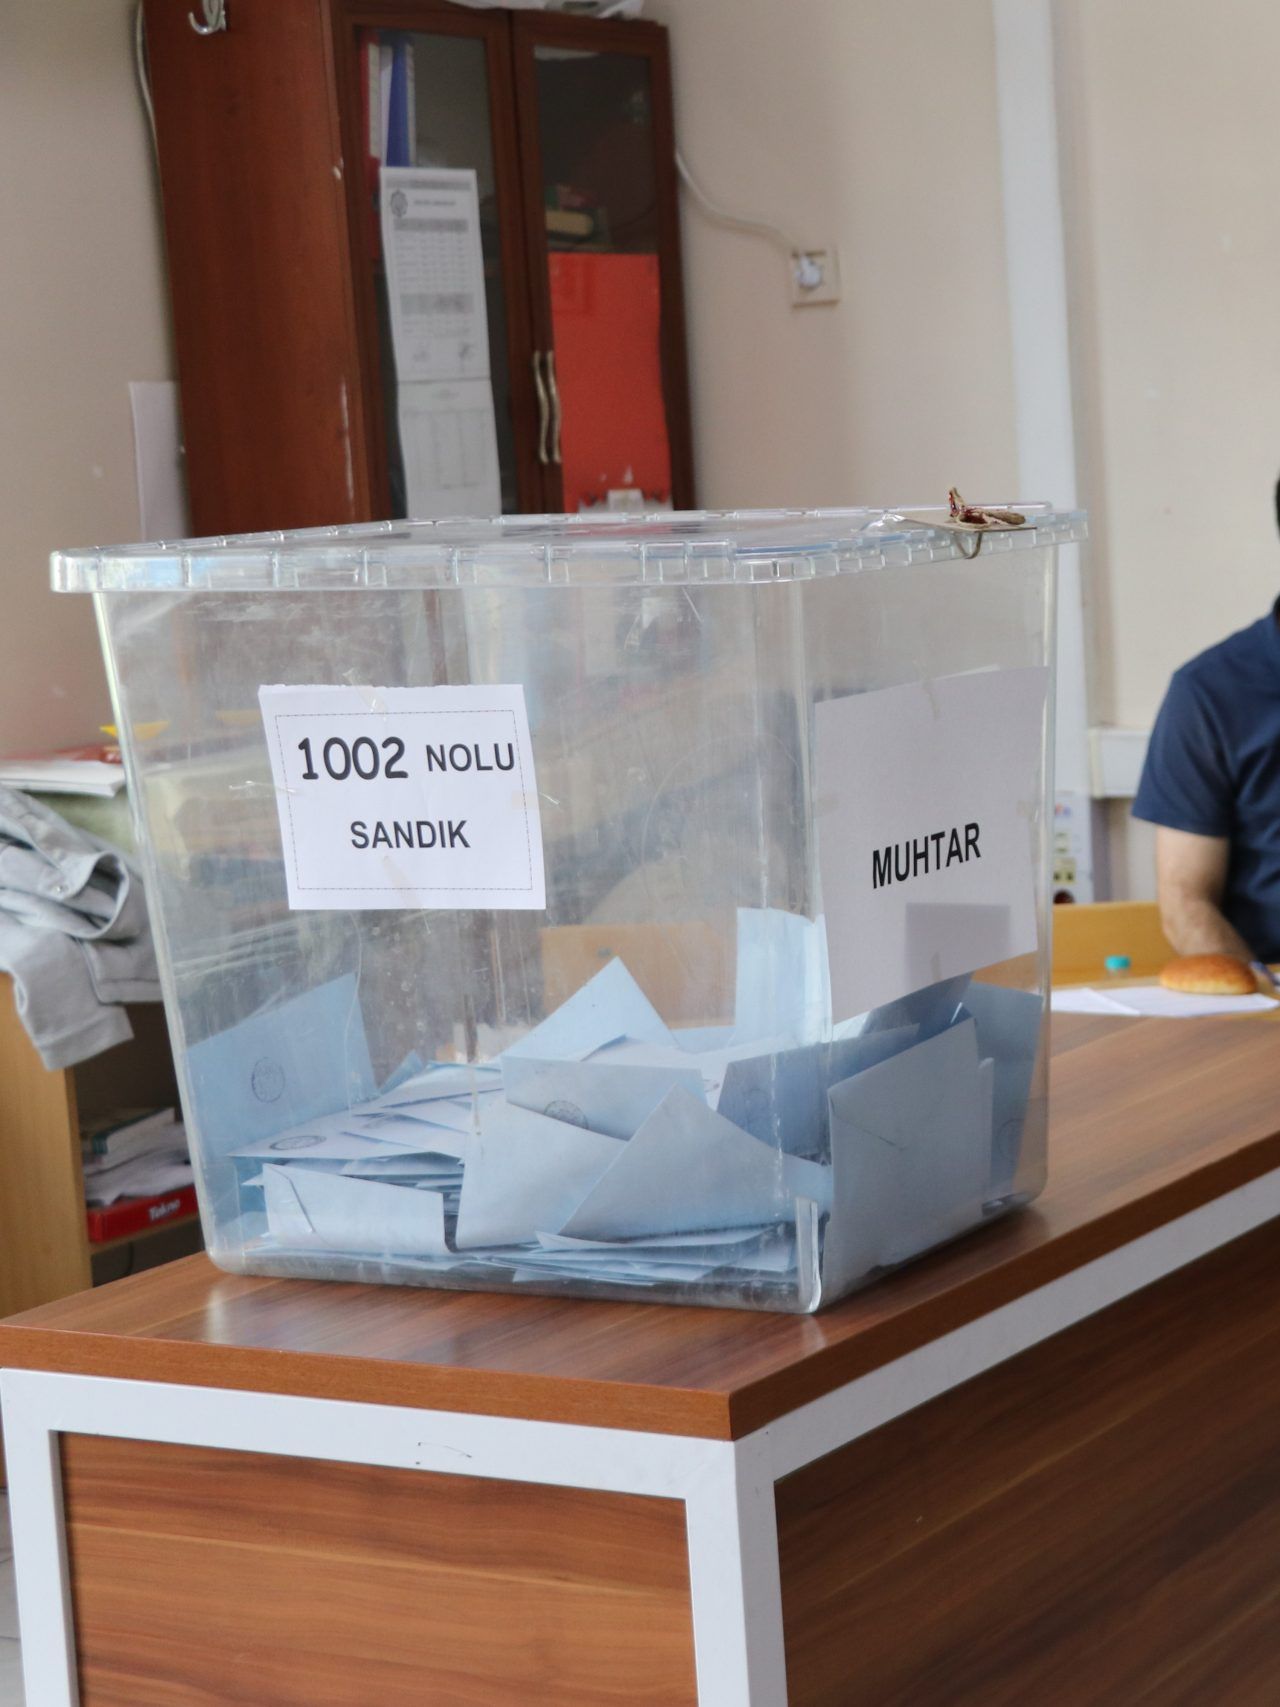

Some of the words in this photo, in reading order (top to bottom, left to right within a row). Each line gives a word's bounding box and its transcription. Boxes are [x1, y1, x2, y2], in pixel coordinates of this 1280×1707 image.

[298, 736, 408, 781] 1002
[425, 743, 515, 772] NOLU
[350, 820, 471, 850] SANDIK
[872, 822, 981, 890] MUHTAR
